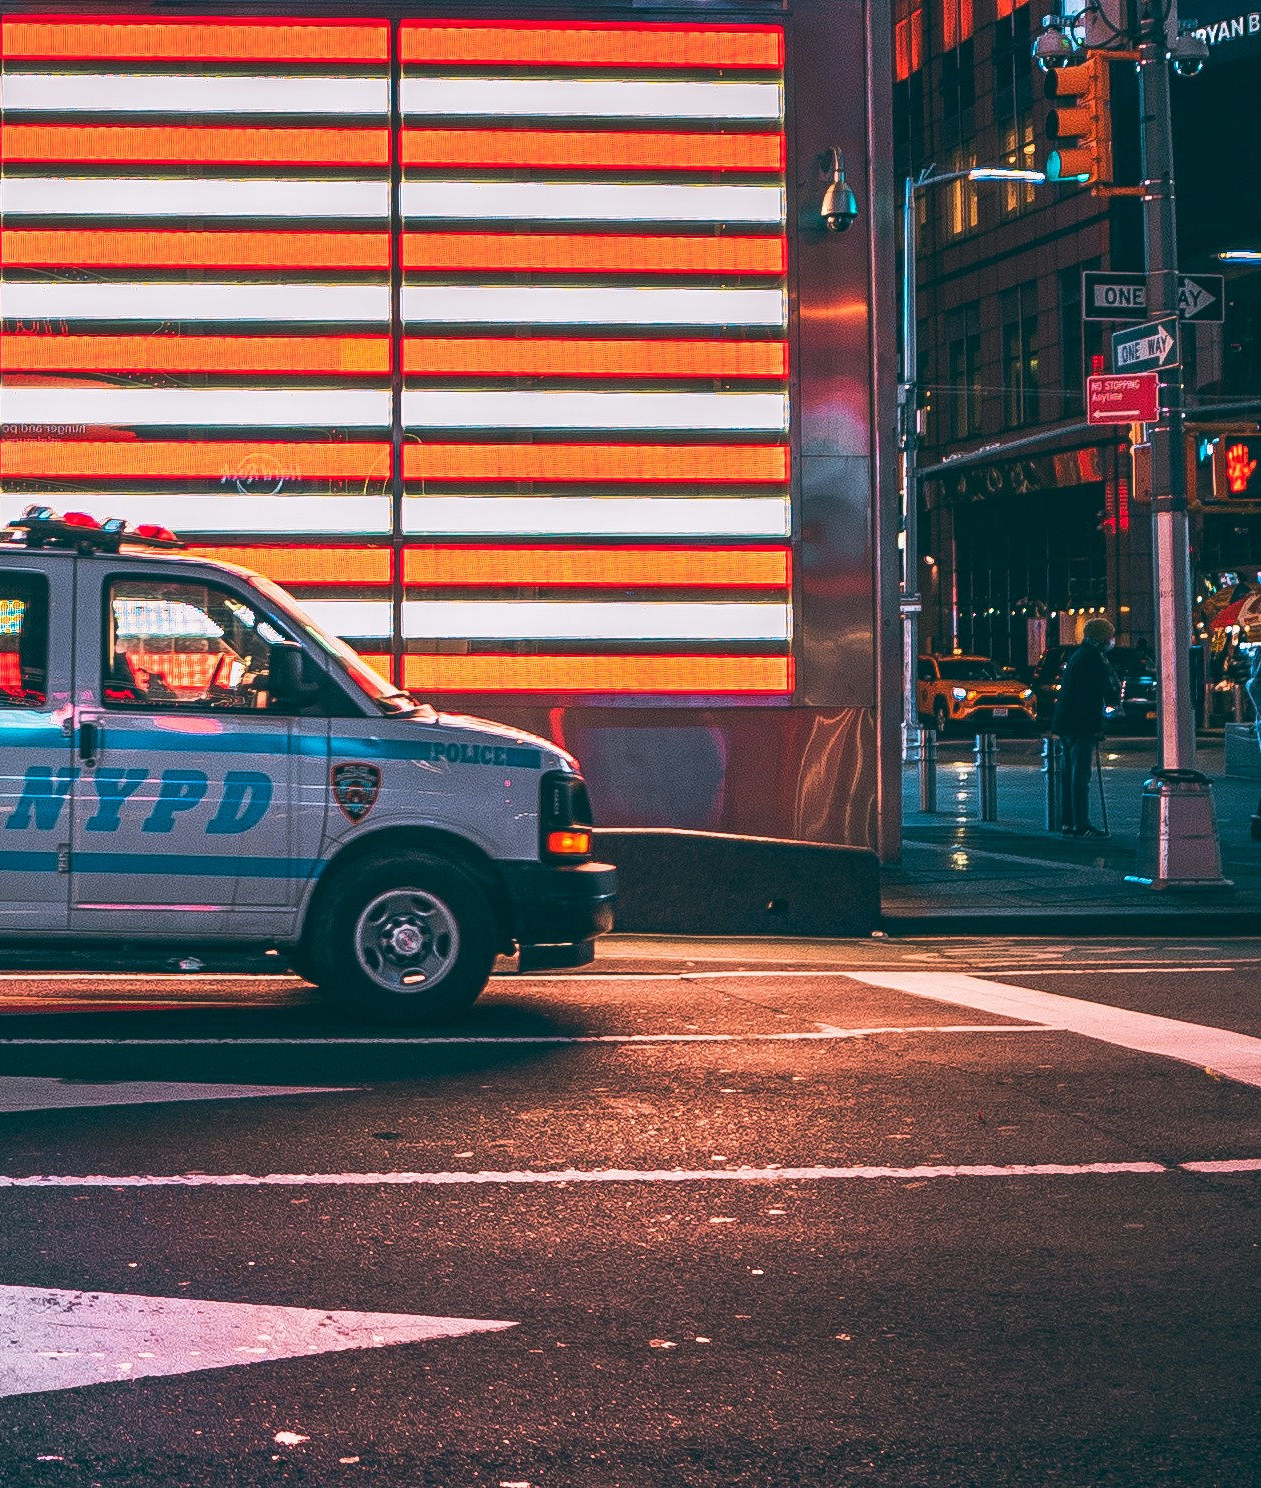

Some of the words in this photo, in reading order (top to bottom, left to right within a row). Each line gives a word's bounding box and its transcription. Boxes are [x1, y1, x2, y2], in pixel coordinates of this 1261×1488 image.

[1191, 16, 1244, 46] RYAN
[1104, 286, 1144, 306] ONE
[1178, 288, 1203, 308] AY
[1122, 341, 1140, 363] ONE
[1148, 334, 1169, 356] WAY
[430, 741, 508, 766] POLICE
[5, 765, 274, 835] NYPD
